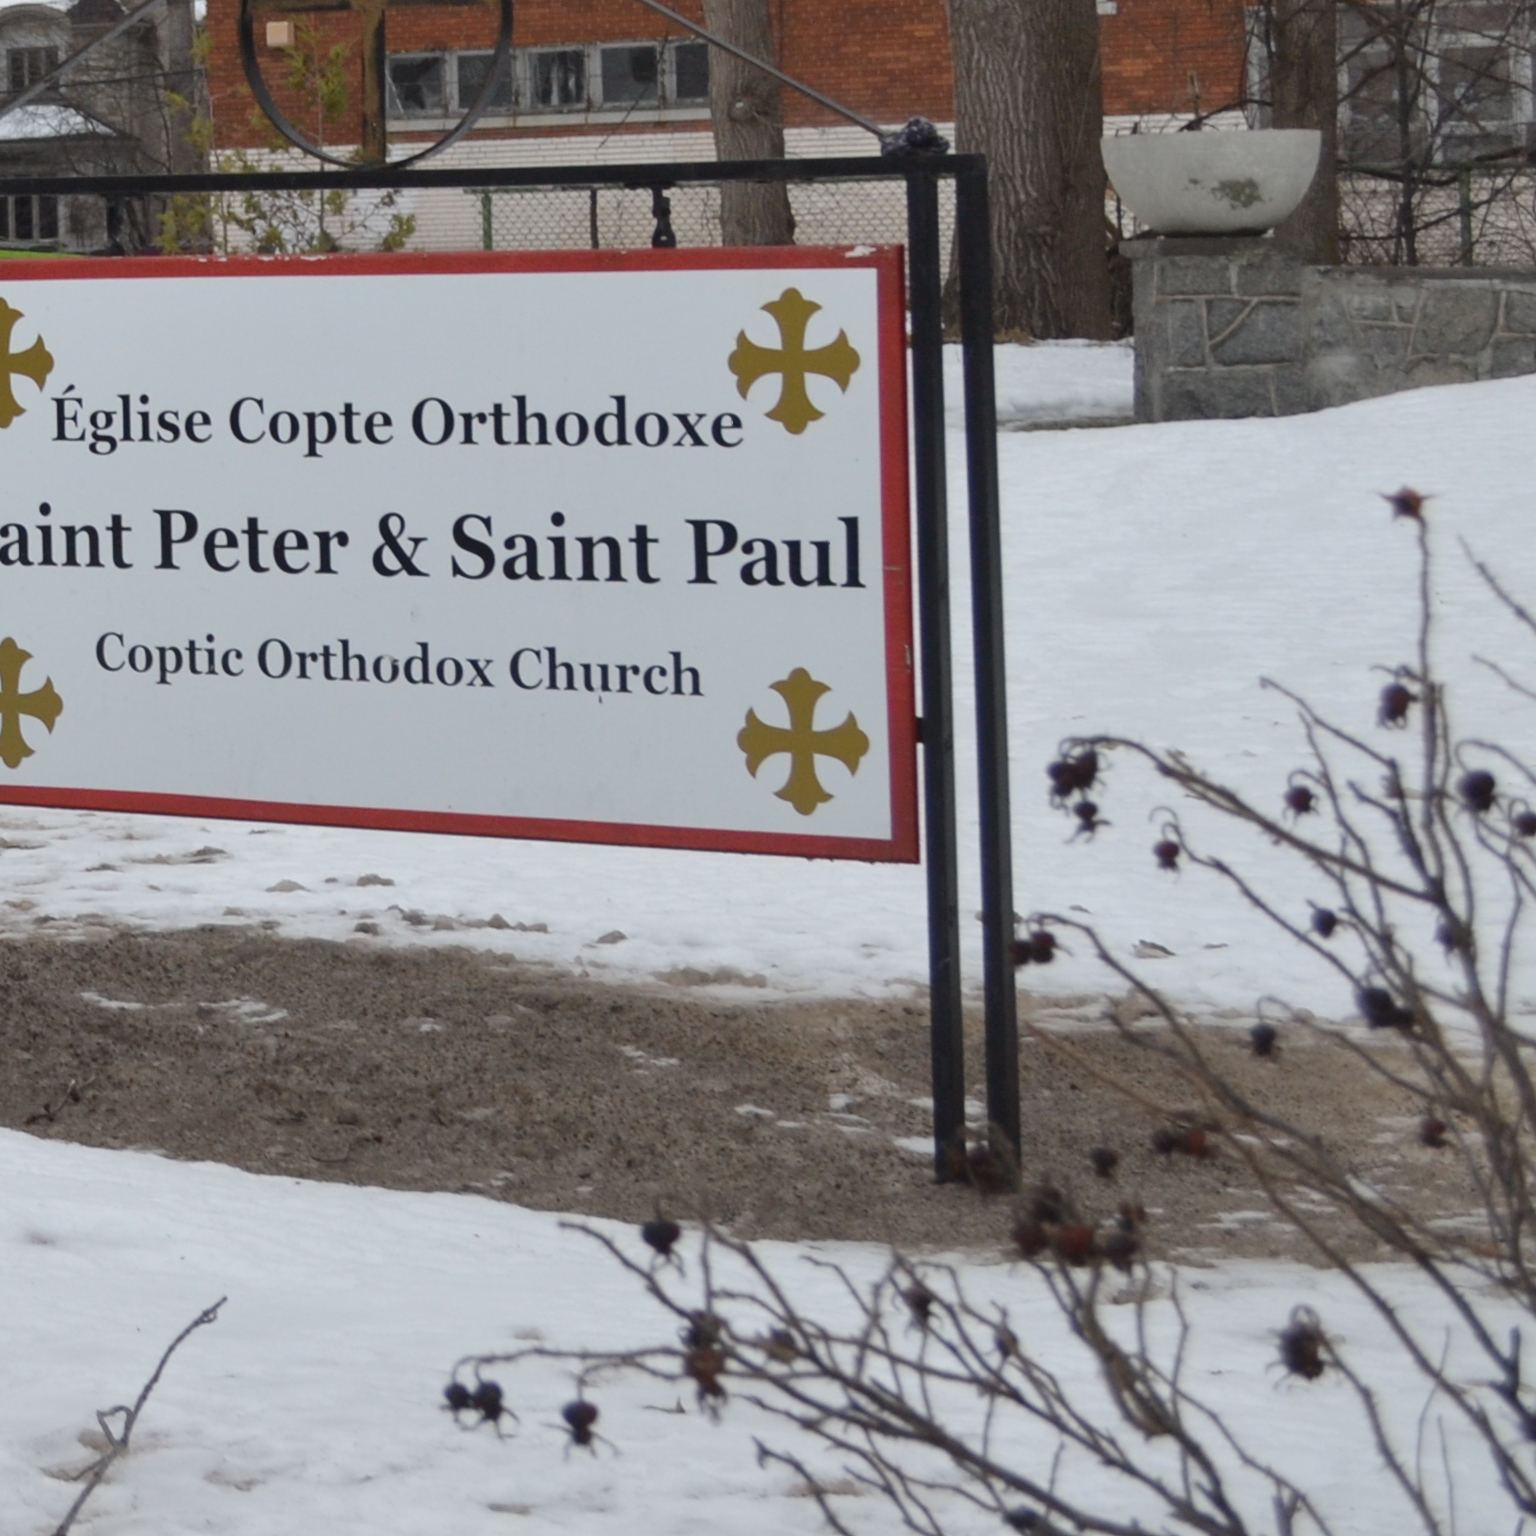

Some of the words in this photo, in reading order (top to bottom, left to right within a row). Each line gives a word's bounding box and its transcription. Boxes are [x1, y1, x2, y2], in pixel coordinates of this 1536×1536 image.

[50, 383, 213, 456] Église
[228, 395, 395, 459] Copte
[410, 393, 744, 448] Orthodoxe
[152, 509, 350, 576] Peter
[371, 512, 431, 578] &
[449, 511, 661, 585] Saint
[684, 515, 867, 590] Paul
[94, 631, 245, 685] Coptic
[256, 637, 496, 689] Orthodox
[508, 645, 704, 698] Church
